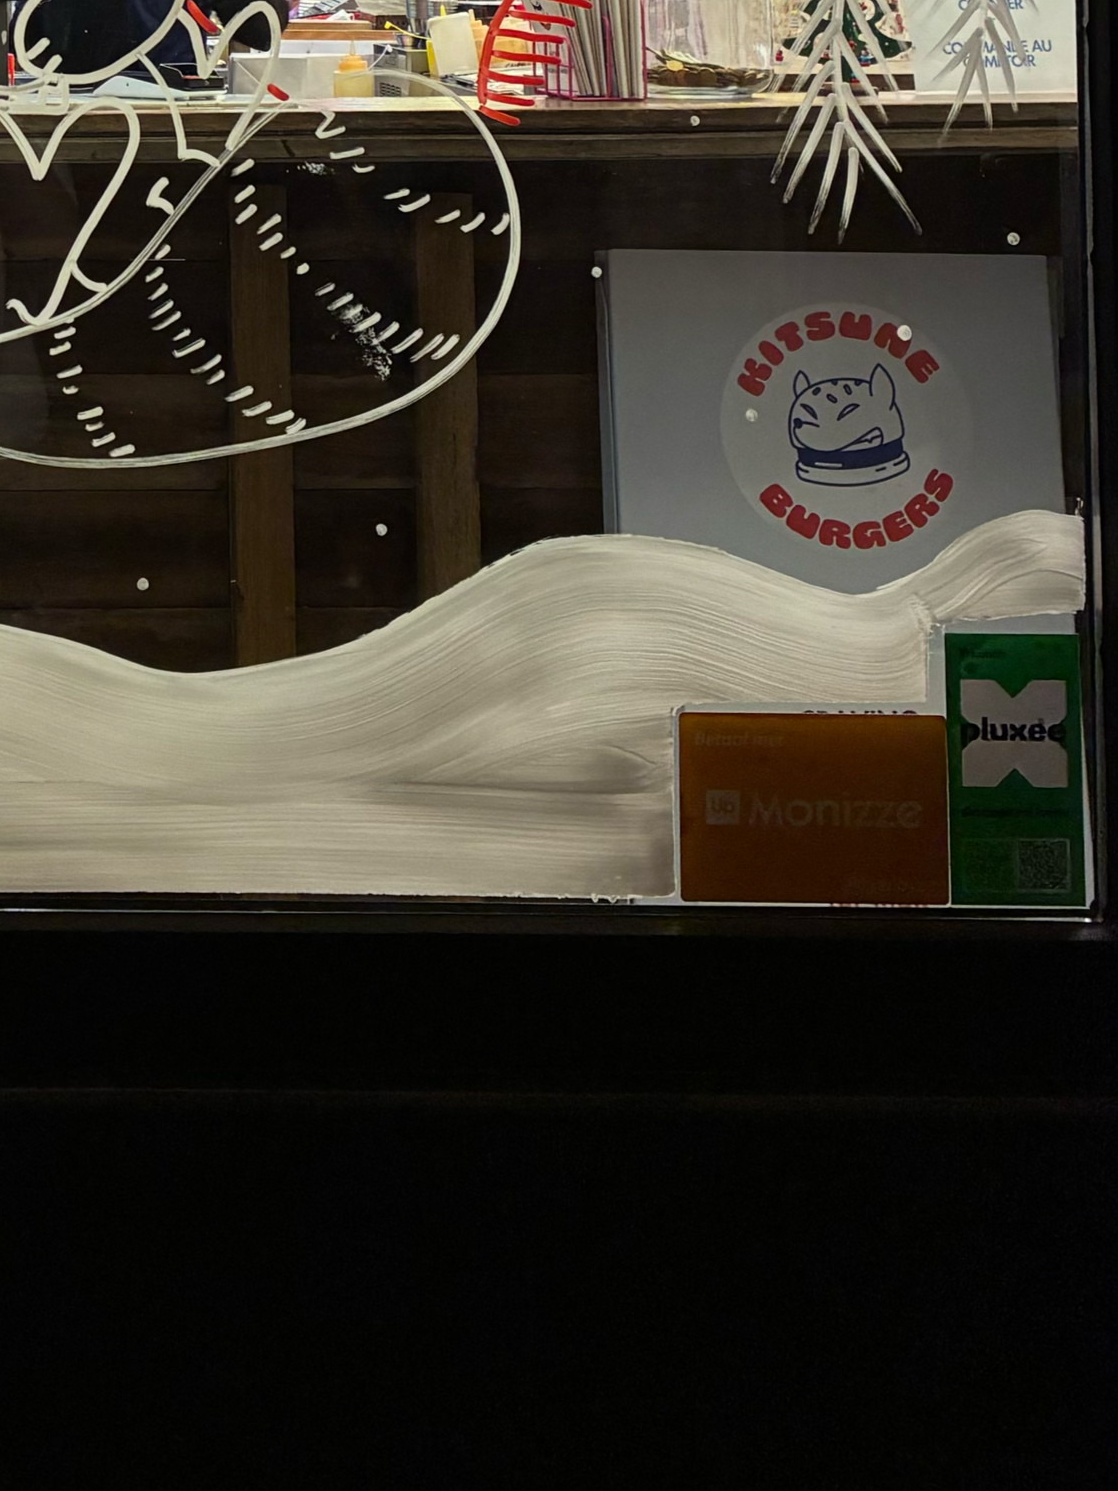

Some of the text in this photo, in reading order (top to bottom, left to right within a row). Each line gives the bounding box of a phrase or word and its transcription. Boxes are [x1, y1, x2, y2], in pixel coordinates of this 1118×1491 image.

[1033, 40, 1052, 52] AU
[737, 310, 940, 397] KITSUNE
[759, 469, 954, 550] BURGERS
